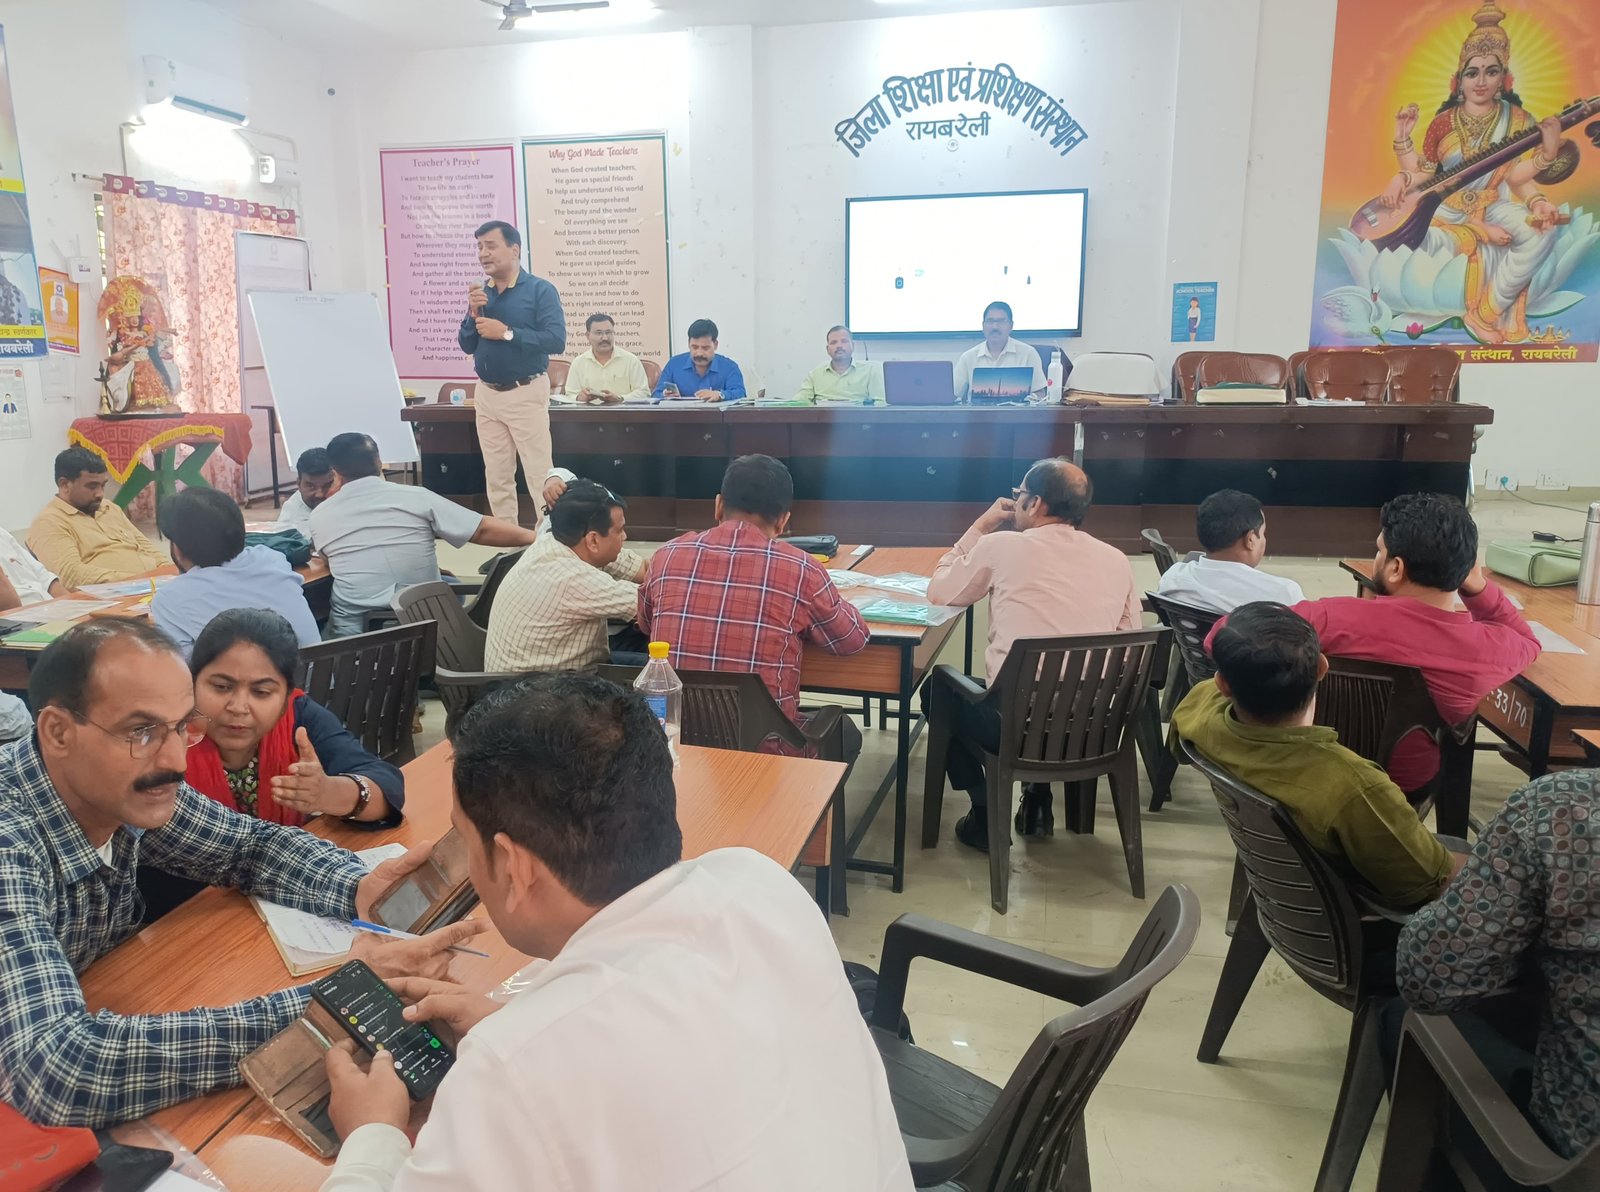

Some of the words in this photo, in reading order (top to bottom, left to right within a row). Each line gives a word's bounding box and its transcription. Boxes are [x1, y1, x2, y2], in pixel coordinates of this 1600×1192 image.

[835, 95, 891, 157] जिला
[882, 68, 944, 118] शिक्षा
[947, 61, 976, 102] एवं
[971, 62, 1047, 124] प्रशिक्षण
[1031, 96, 1088, 157] संस्थान
[548, 149, 565, 160] Why
[567, 149, 582, 160] God
[584, 147, 604, 157] Made
[607, 146, 638, 157] Teachers
[412, 158, 450, 168] Teacher's
[453, 158, 480, 168] Prayer
[590, 176, 610, 184] special
[555, 188, 568, 196] help
[575, 198, 589, 206] truly
[573, 218, 606, 226] everything
[598, 238, 628, 246] discovery.
[1521, 346, 1578, 360] रायबरेली
